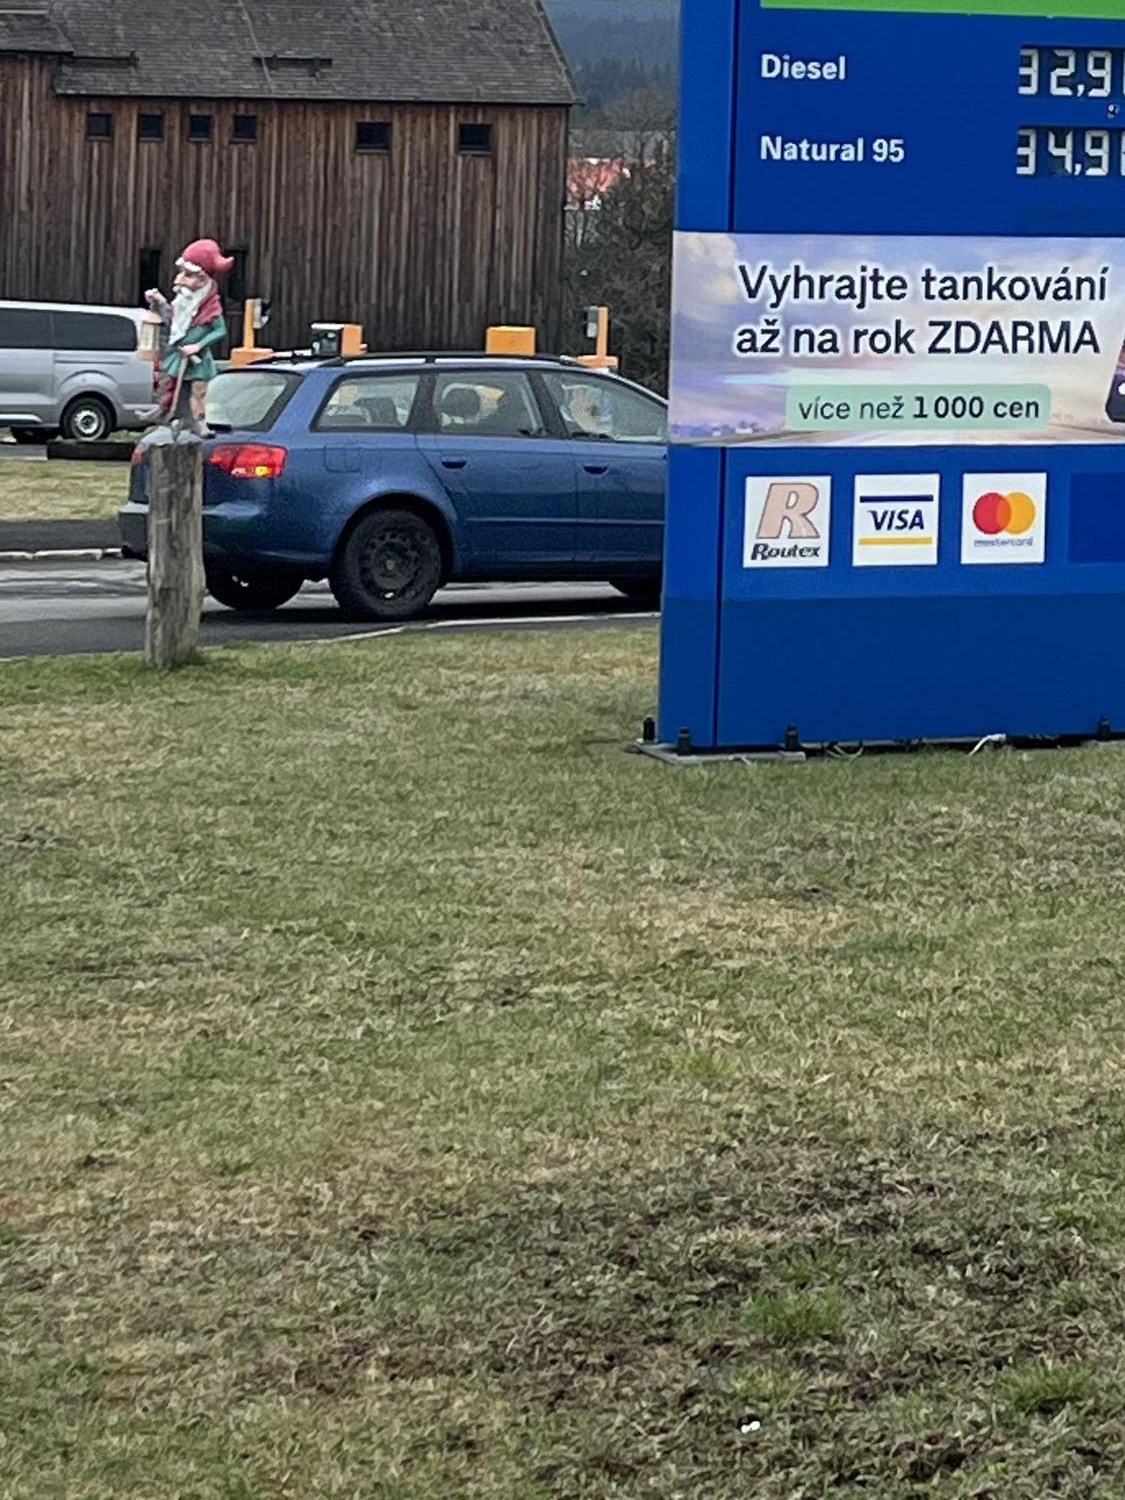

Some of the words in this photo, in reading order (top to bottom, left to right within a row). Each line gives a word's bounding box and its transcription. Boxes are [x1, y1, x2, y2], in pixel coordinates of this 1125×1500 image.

[761, 53, 846, 81] Diesel
[760, 135, 864, 162] Natural
[872, 138, 905, 163] 95
[738, 264, 908, 309] Vyhrajte
[921, 266, 1110, 301] tankování
[736, 319, 780, 353] až
[794, 328, 839, 353] na
[853, 319, 916, 354] rok
[927, 320, 1101, 354] ZDARMA
[799, 395, 850, 419] více
[859, 395, 905, 419] než
[993, 400, 1040, 418] cen
[868, 509, 925, 531] VISA
[751, 543, 821, 561] Routex
